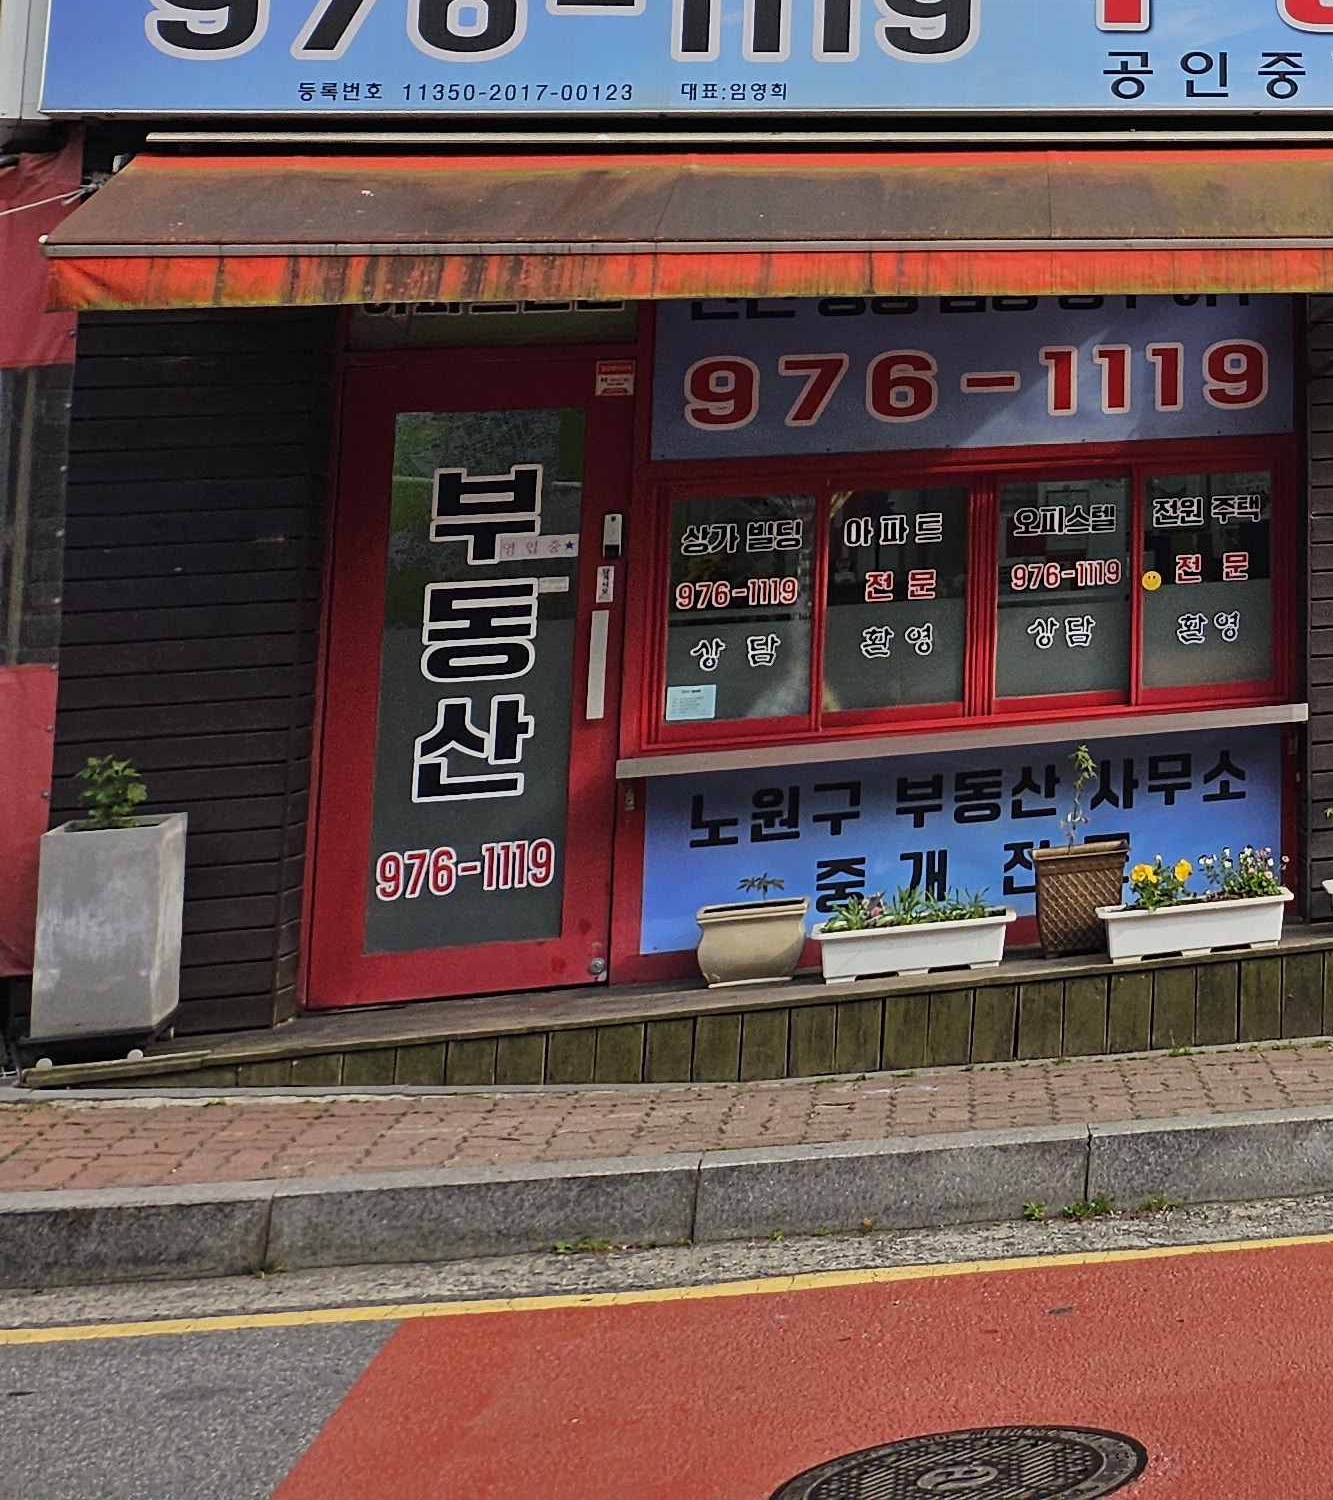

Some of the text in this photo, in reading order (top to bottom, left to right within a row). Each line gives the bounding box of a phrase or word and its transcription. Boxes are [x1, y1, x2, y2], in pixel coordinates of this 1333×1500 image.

[297, 82, 384, 102] 등록번호
[402, 83, 634, 102] 11350-2017-00123
[683, 338, 1269, 432] 976-1119
[842, 511, 944, 548] 아파트
[1012, 503, 1118, 538] 오피스텔
[1151, 493, 1262, 529] 전원 주택
[681, 517, 804, 555] 상가 빌딩
[675, 575, 800, 611] 976-1119
[864, 568, 939, 604] 전문
[1009, 557, 1123, 592] 976-1119
[411, 462, 543, 805] 부동산
[1026, 613, 1098, 651] 상담
[689, 748, 1248, 850] 노원구 부동산 사무소
[375, 837, 556, 903] 976-1119
